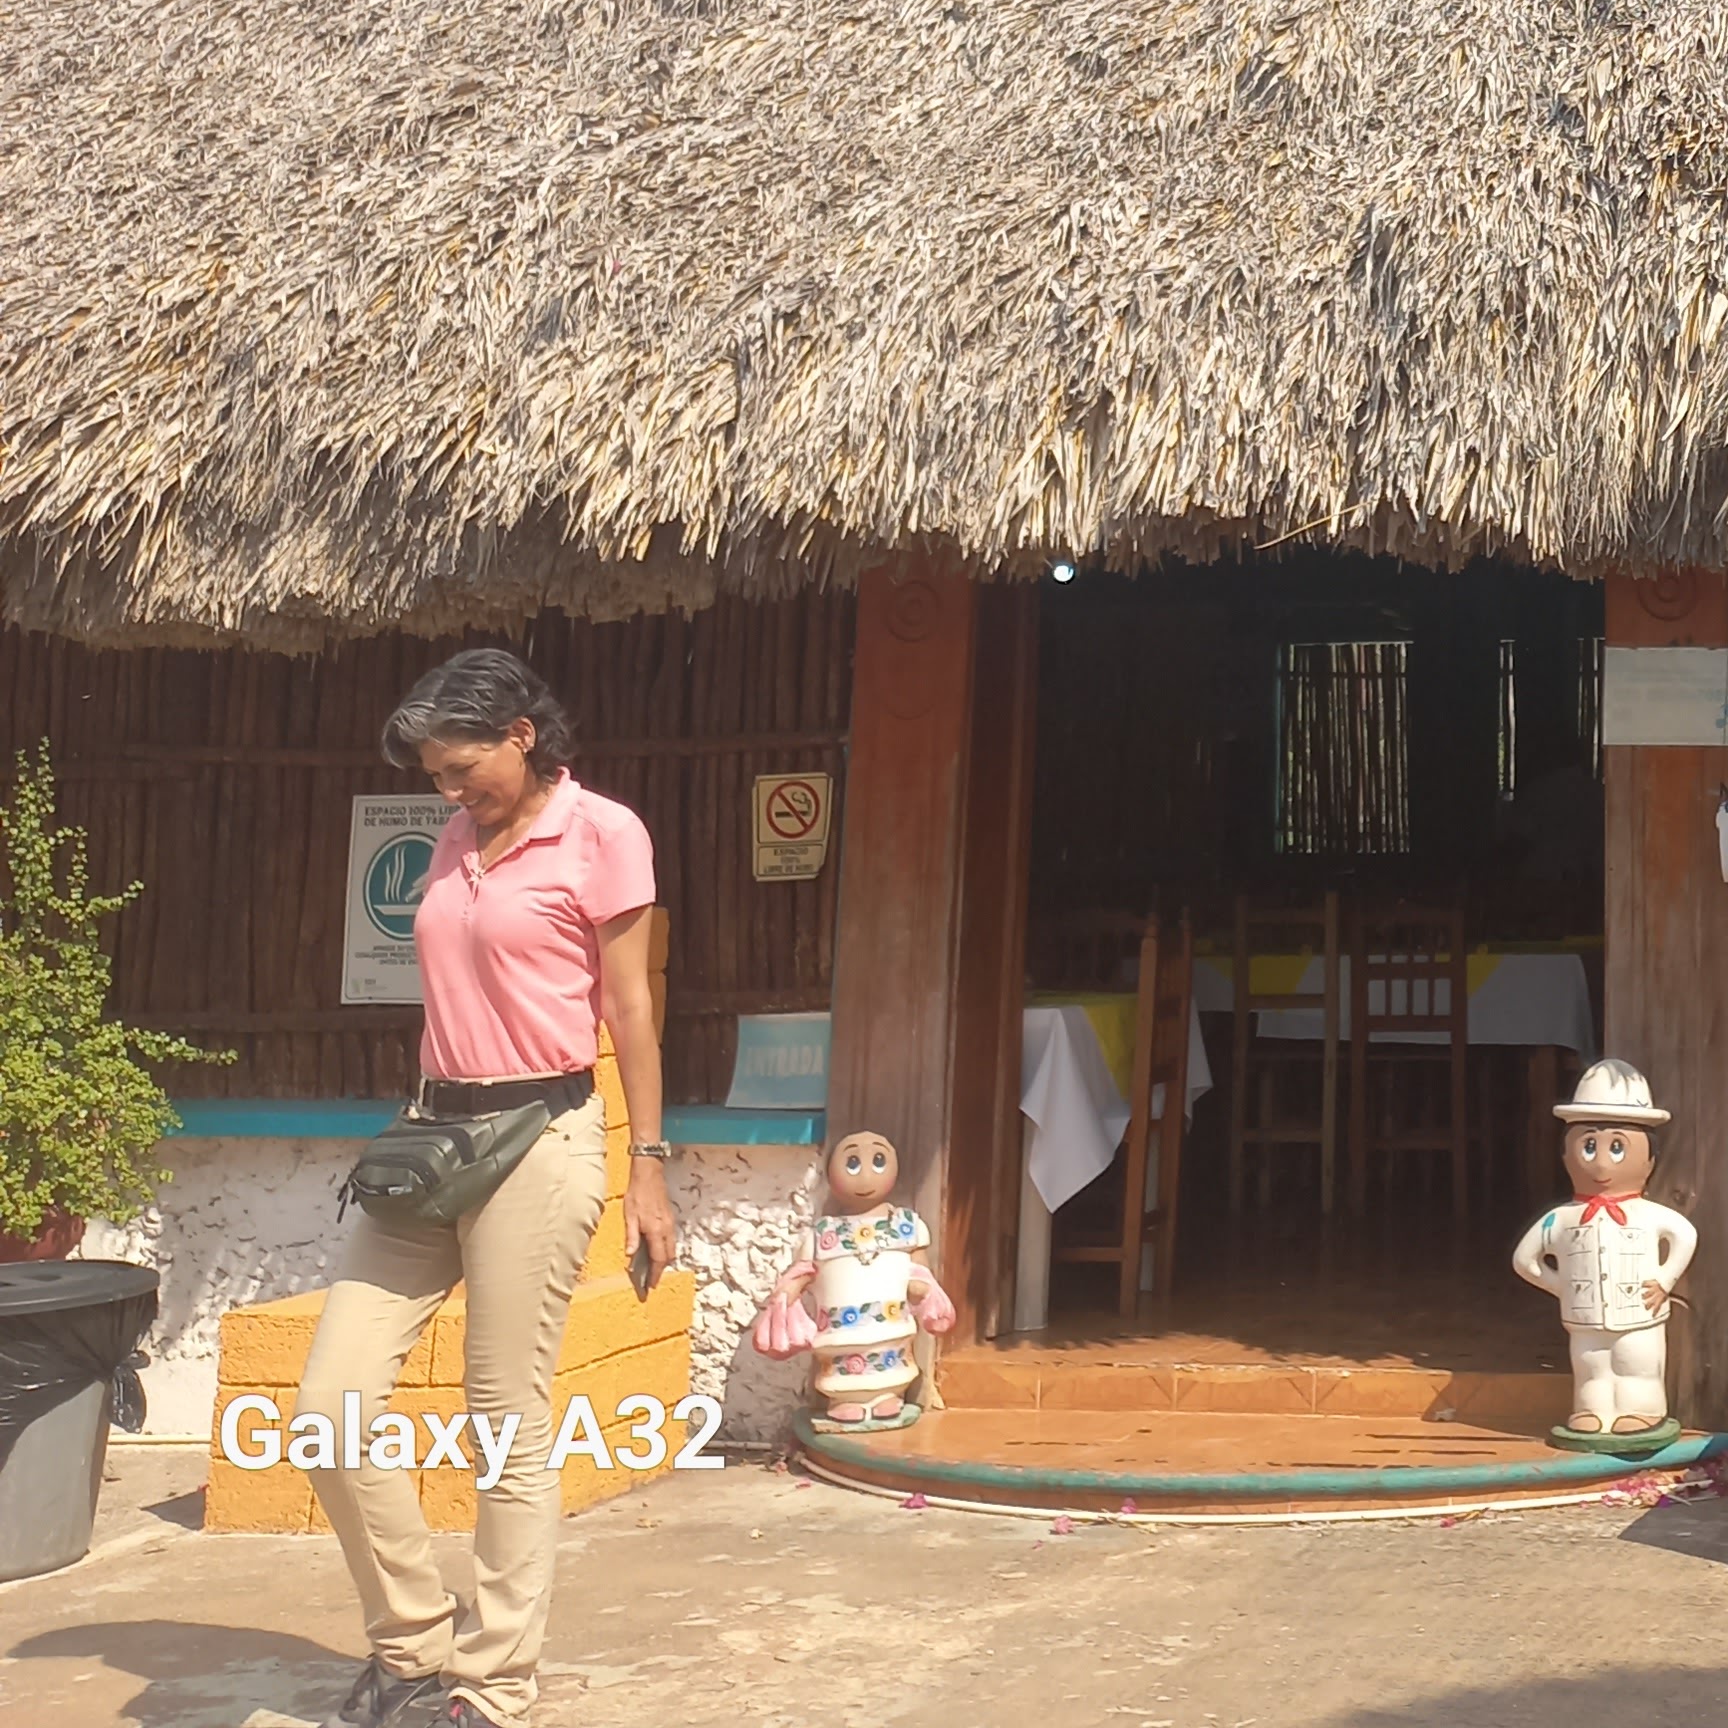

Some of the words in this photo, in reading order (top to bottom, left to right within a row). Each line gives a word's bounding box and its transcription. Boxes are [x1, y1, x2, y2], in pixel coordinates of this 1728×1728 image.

[364, 805, 406, 816] ESPACIO
[364, 817, 376, 827] DE
[379, 817, 408, 826] HUMO
[410, 817, 423, 826] DE
[746, 1044, 824, 1077] ENTRADA
